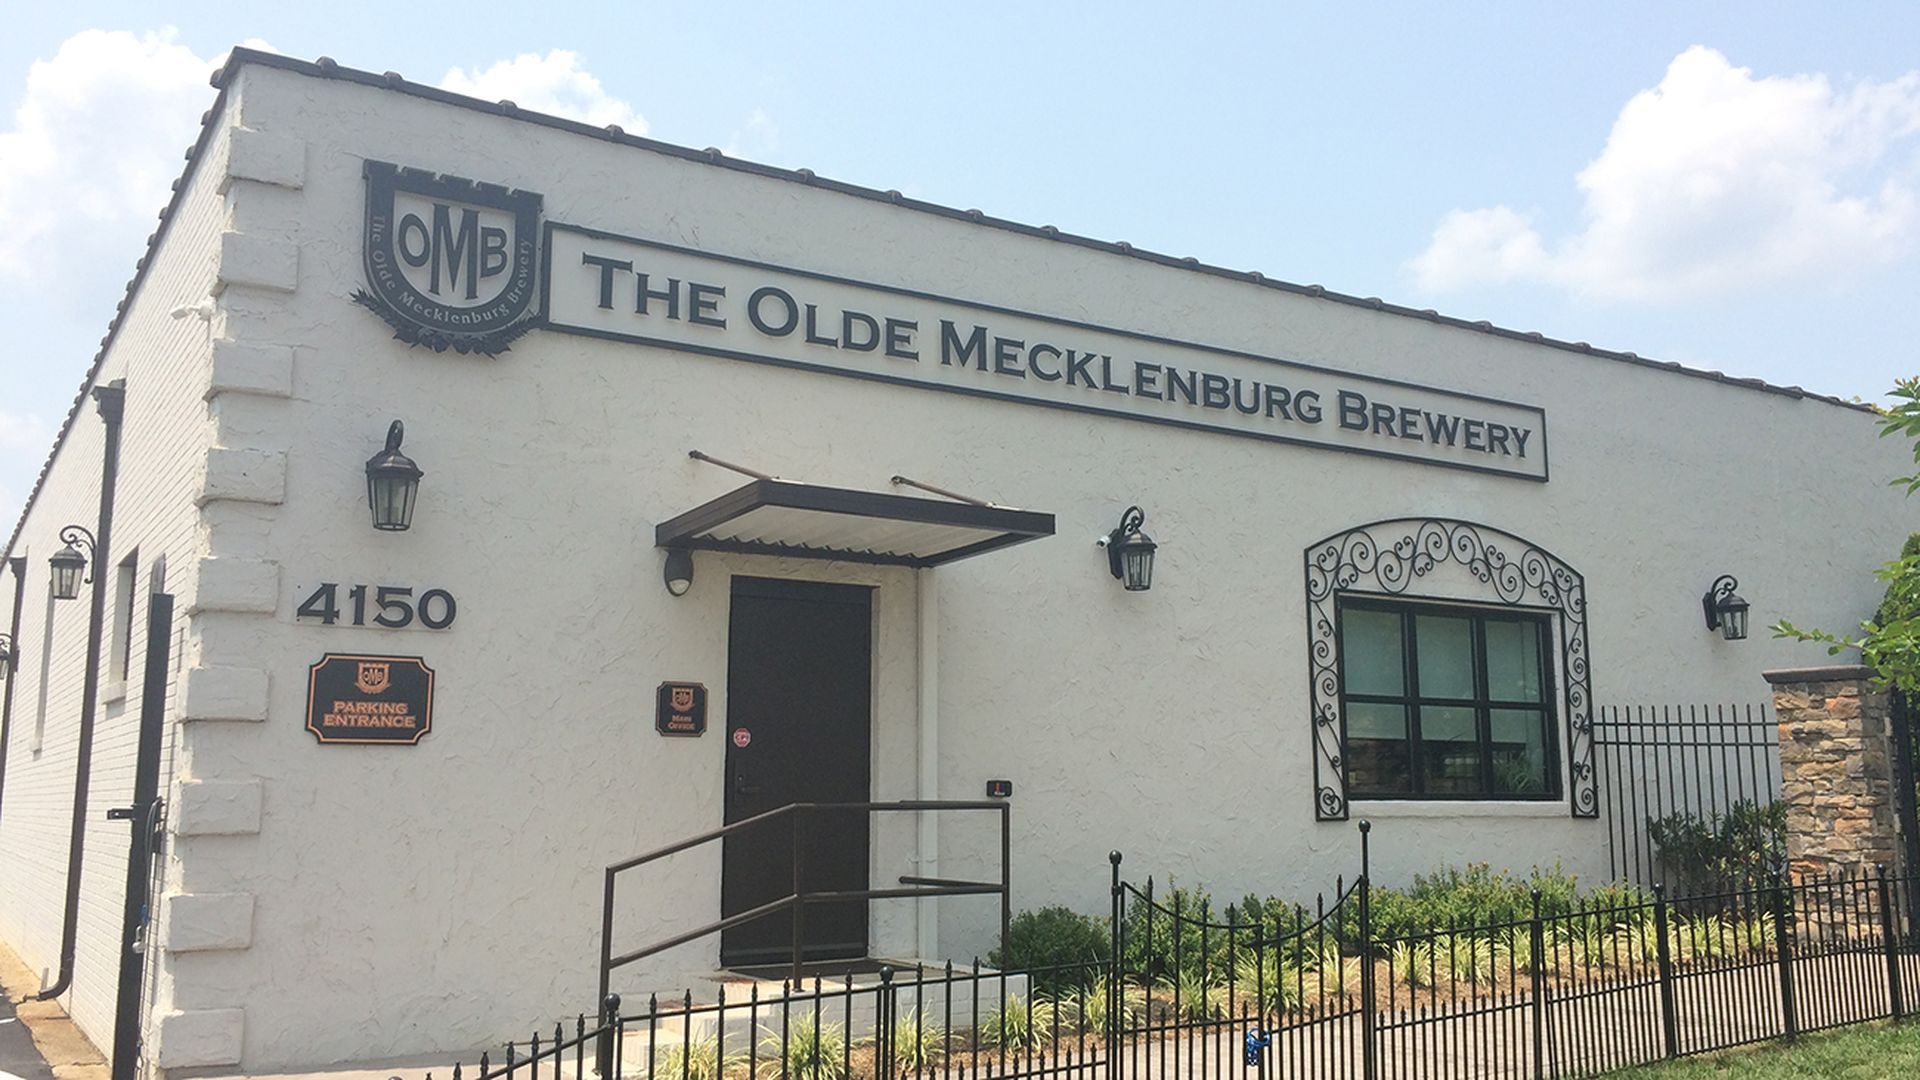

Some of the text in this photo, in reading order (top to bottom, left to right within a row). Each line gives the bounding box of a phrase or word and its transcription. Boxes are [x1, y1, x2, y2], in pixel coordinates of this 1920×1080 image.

[372, 214, 534, 325] The Olde Mecklenburg Brewery
[399, 203, 508, 300] OMB
[582, 251, 1533, 459] THE OLDE MECKLENBURG BREWERY
[296, 582, 457, 630] 4150
[322, 713, 416, 729] ENTRANCE
[332, 700, 409, 714] PARKING
